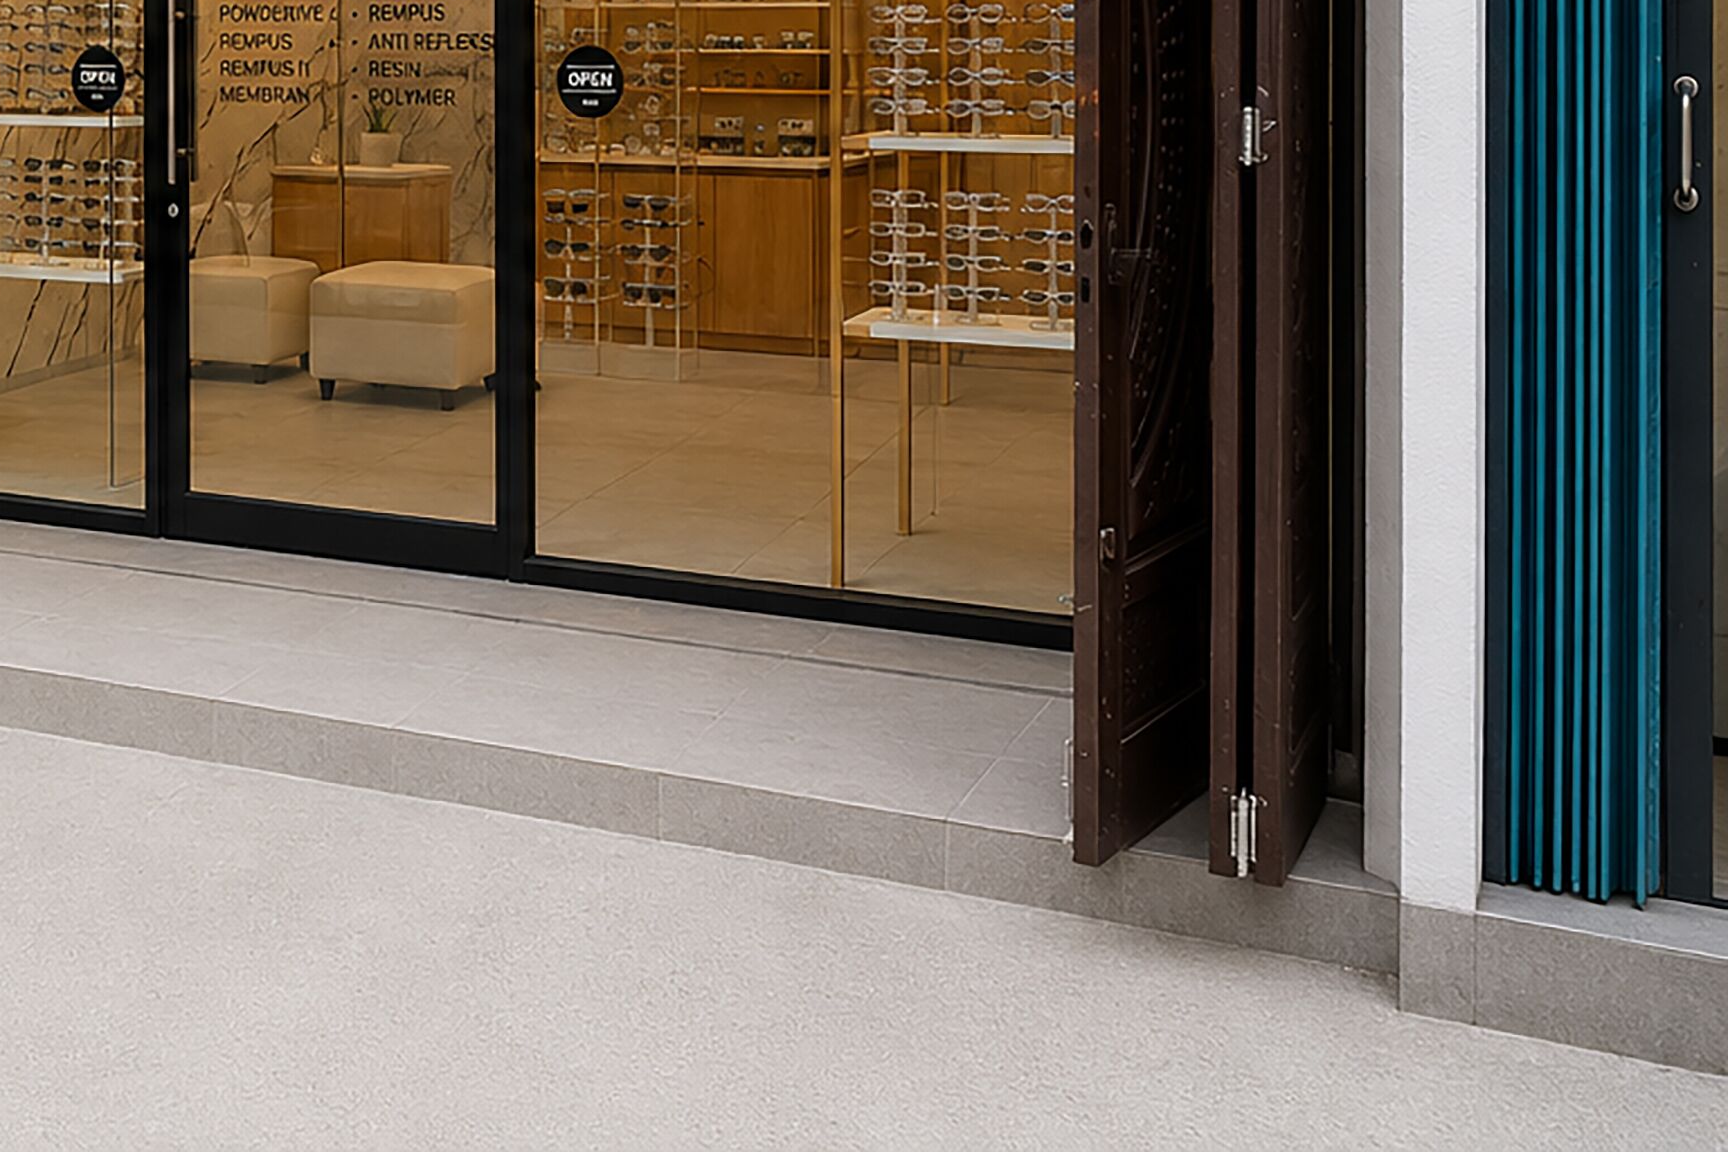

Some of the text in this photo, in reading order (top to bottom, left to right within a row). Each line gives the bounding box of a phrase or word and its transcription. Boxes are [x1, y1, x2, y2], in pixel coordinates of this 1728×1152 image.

[368, 32, 408, 51] ANTI
[368, 60, 421, 78] RESIN
[568, 71, 613, 87] OPEN
[368, 87, 457, 106] POLYMER
